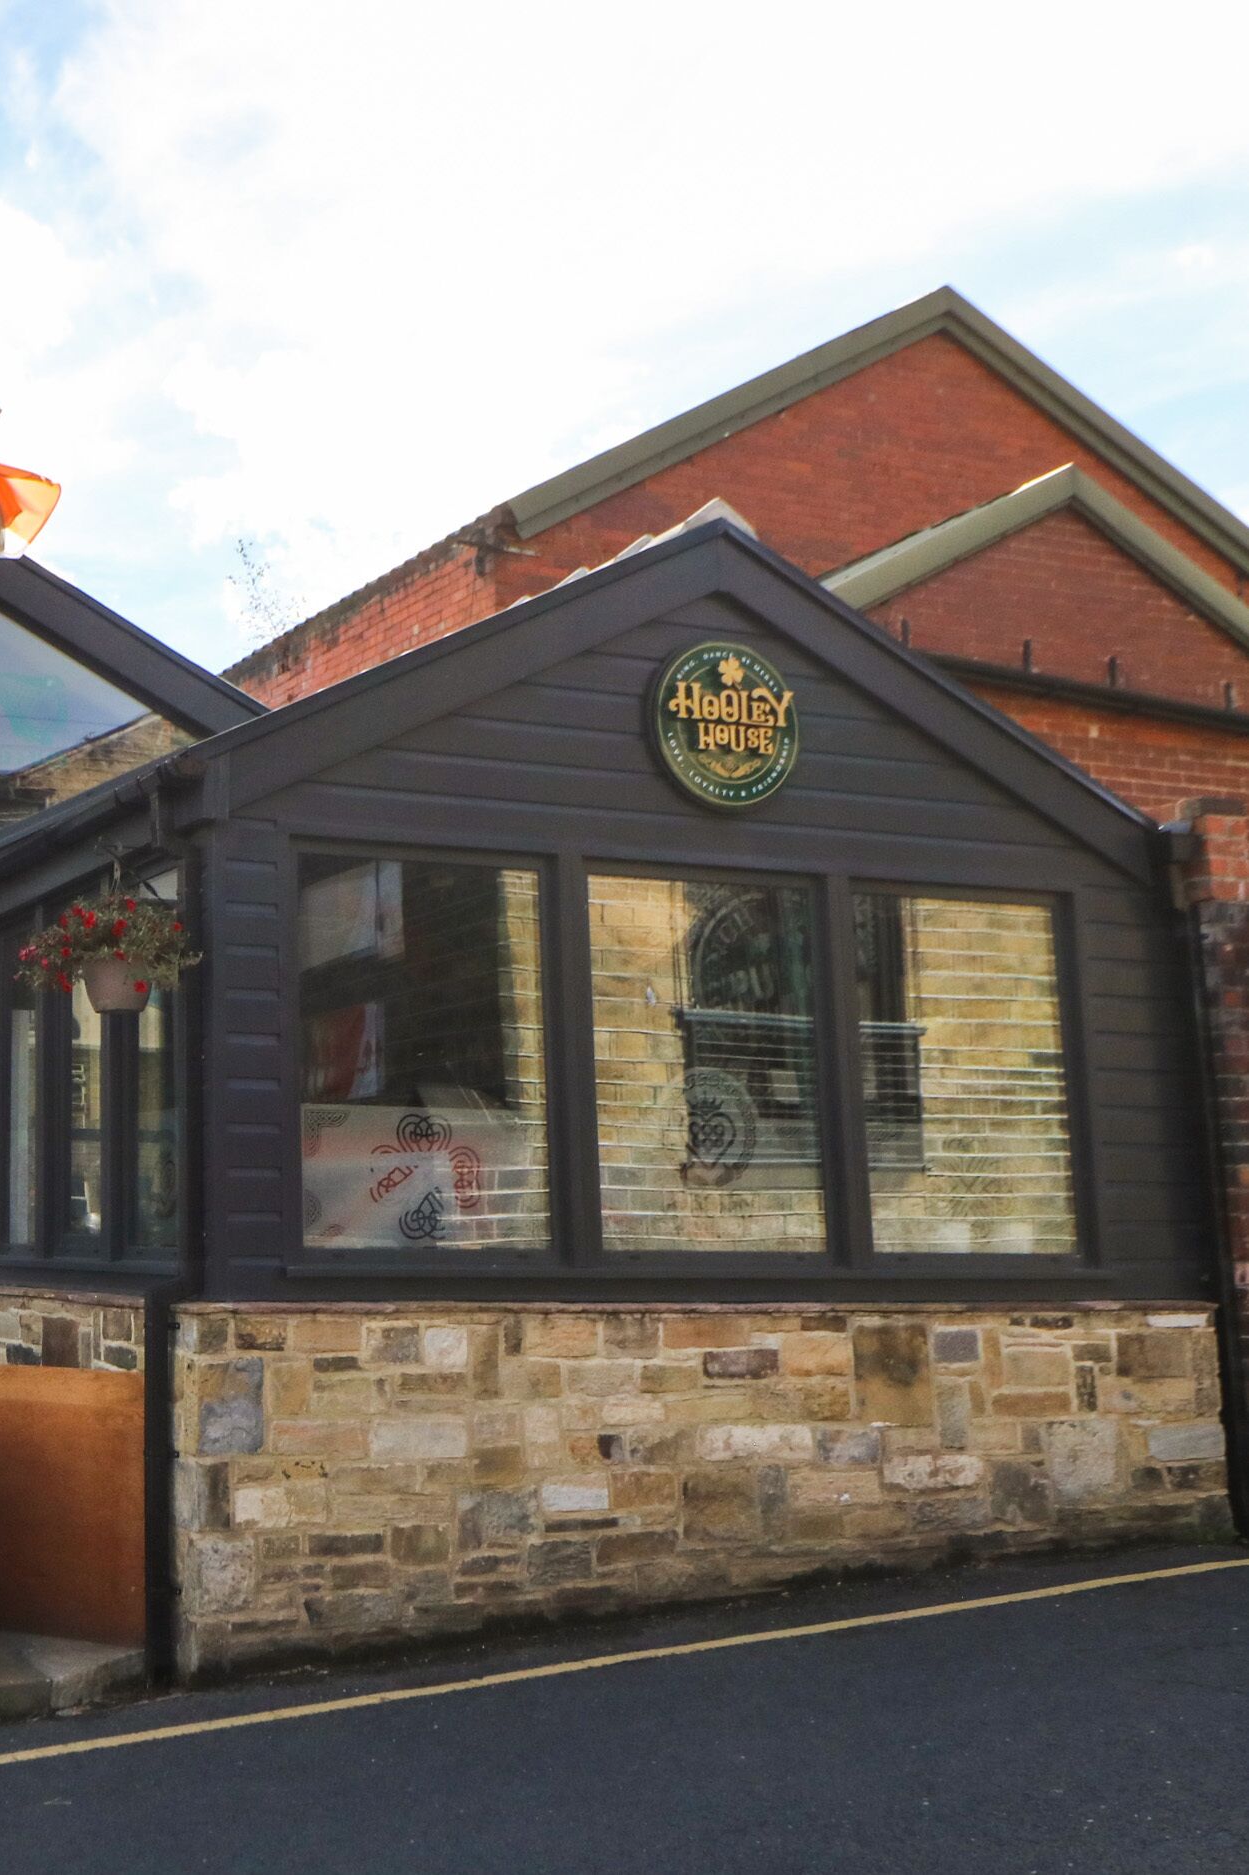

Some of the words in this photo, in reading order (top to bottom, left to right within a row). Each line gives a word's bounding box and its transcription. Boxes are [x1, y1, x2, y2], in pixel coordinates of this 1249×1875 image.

[668, 680, 795, 727] HOOLEY
[697, 723, 775, 756] HOUSE
[689, 770, 735, 798] LOYALTY
